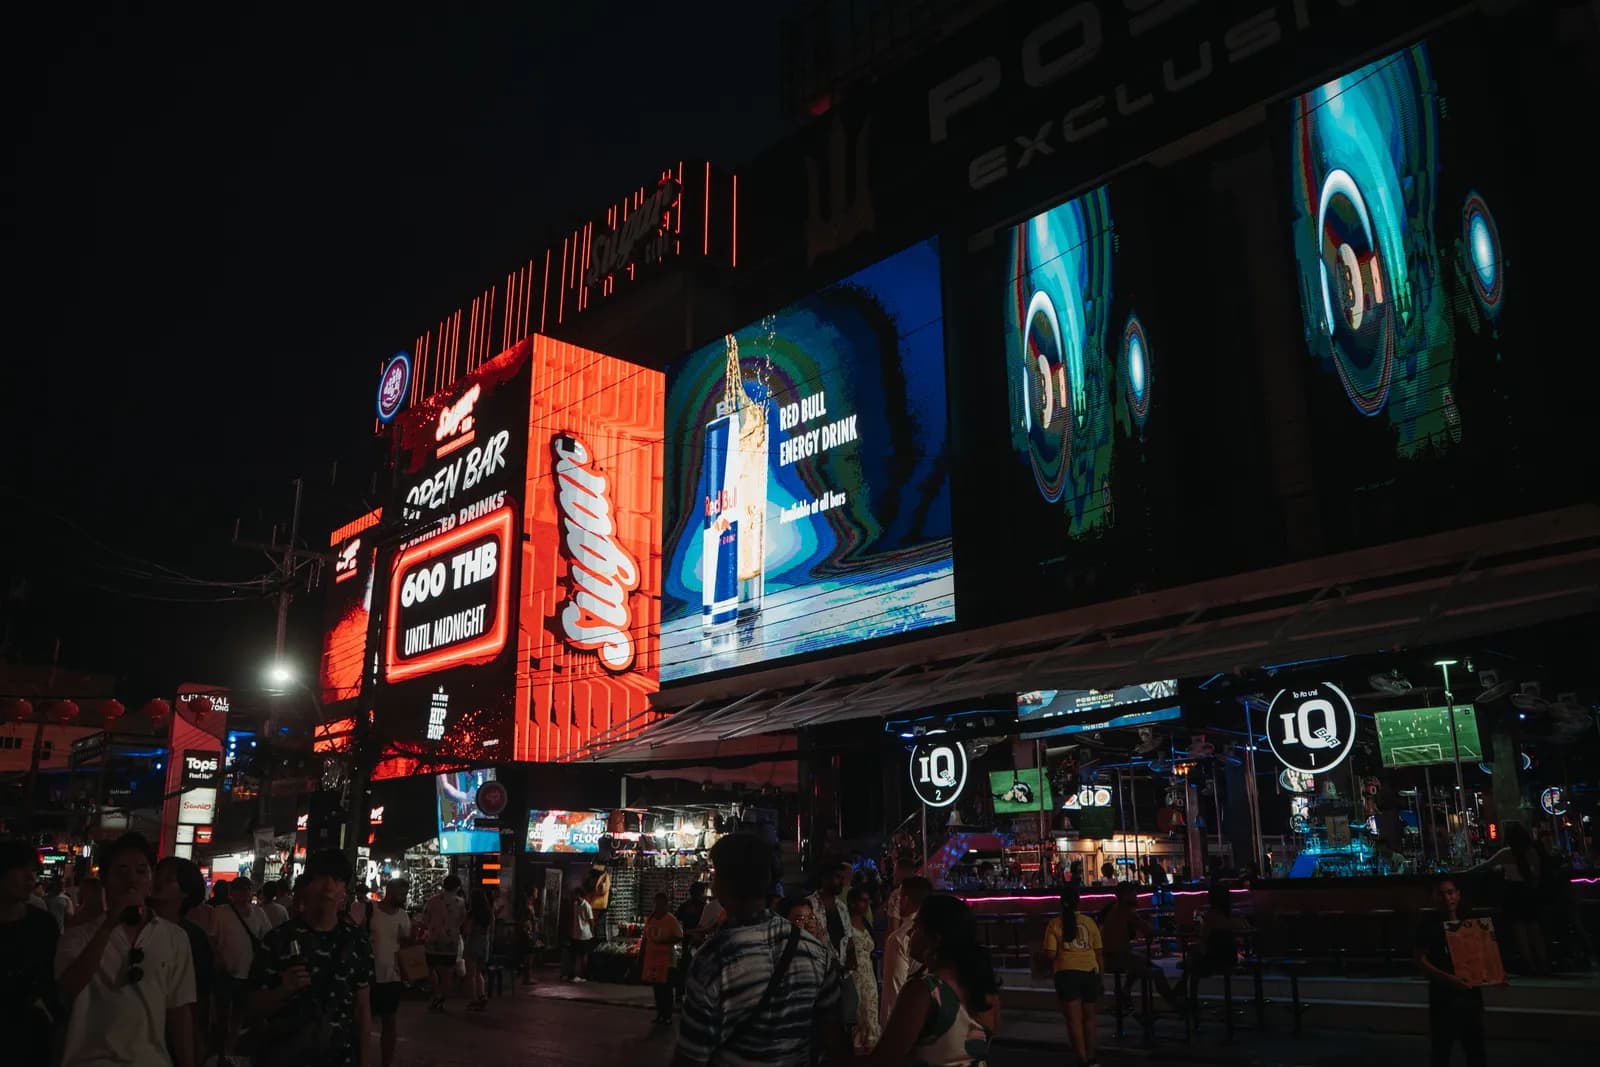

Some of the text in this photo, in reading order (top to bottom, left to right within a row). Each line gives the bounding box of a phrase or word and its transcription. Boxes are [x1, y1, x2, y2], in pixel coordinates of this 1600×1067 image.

[968, 0, 1352, 190] EXCLUSI
[780, 391, 826, 432] RED BULL
[780, 414, 858, 467] ENERGY DRINK
[463, 430, 510, 491] BAR
[459, 490, 507, 526] DRINKS
[819, 491, 829, 512] all
[830, 490, 846, 509] bars
[554, 433, 638, 668] Sugar
[401, 542, 498, 608] 600 THB
[404, 604, 487, 656] UNTIL MIDNIGHT
[427, 725, 445, 741] HOP
[1280, 699, 1341, 749] IQ
[1315, 729, 1340, 748] BAR
[186, 757, 218, 772] Tops
[919, 747, 956, 787] IQ
[1309, 753, 1316, 766] 1
[935, 789, 942, 801] 2
[572, 832, 600, 844] FLOO
[580, 823, 602, 834] 4TH
